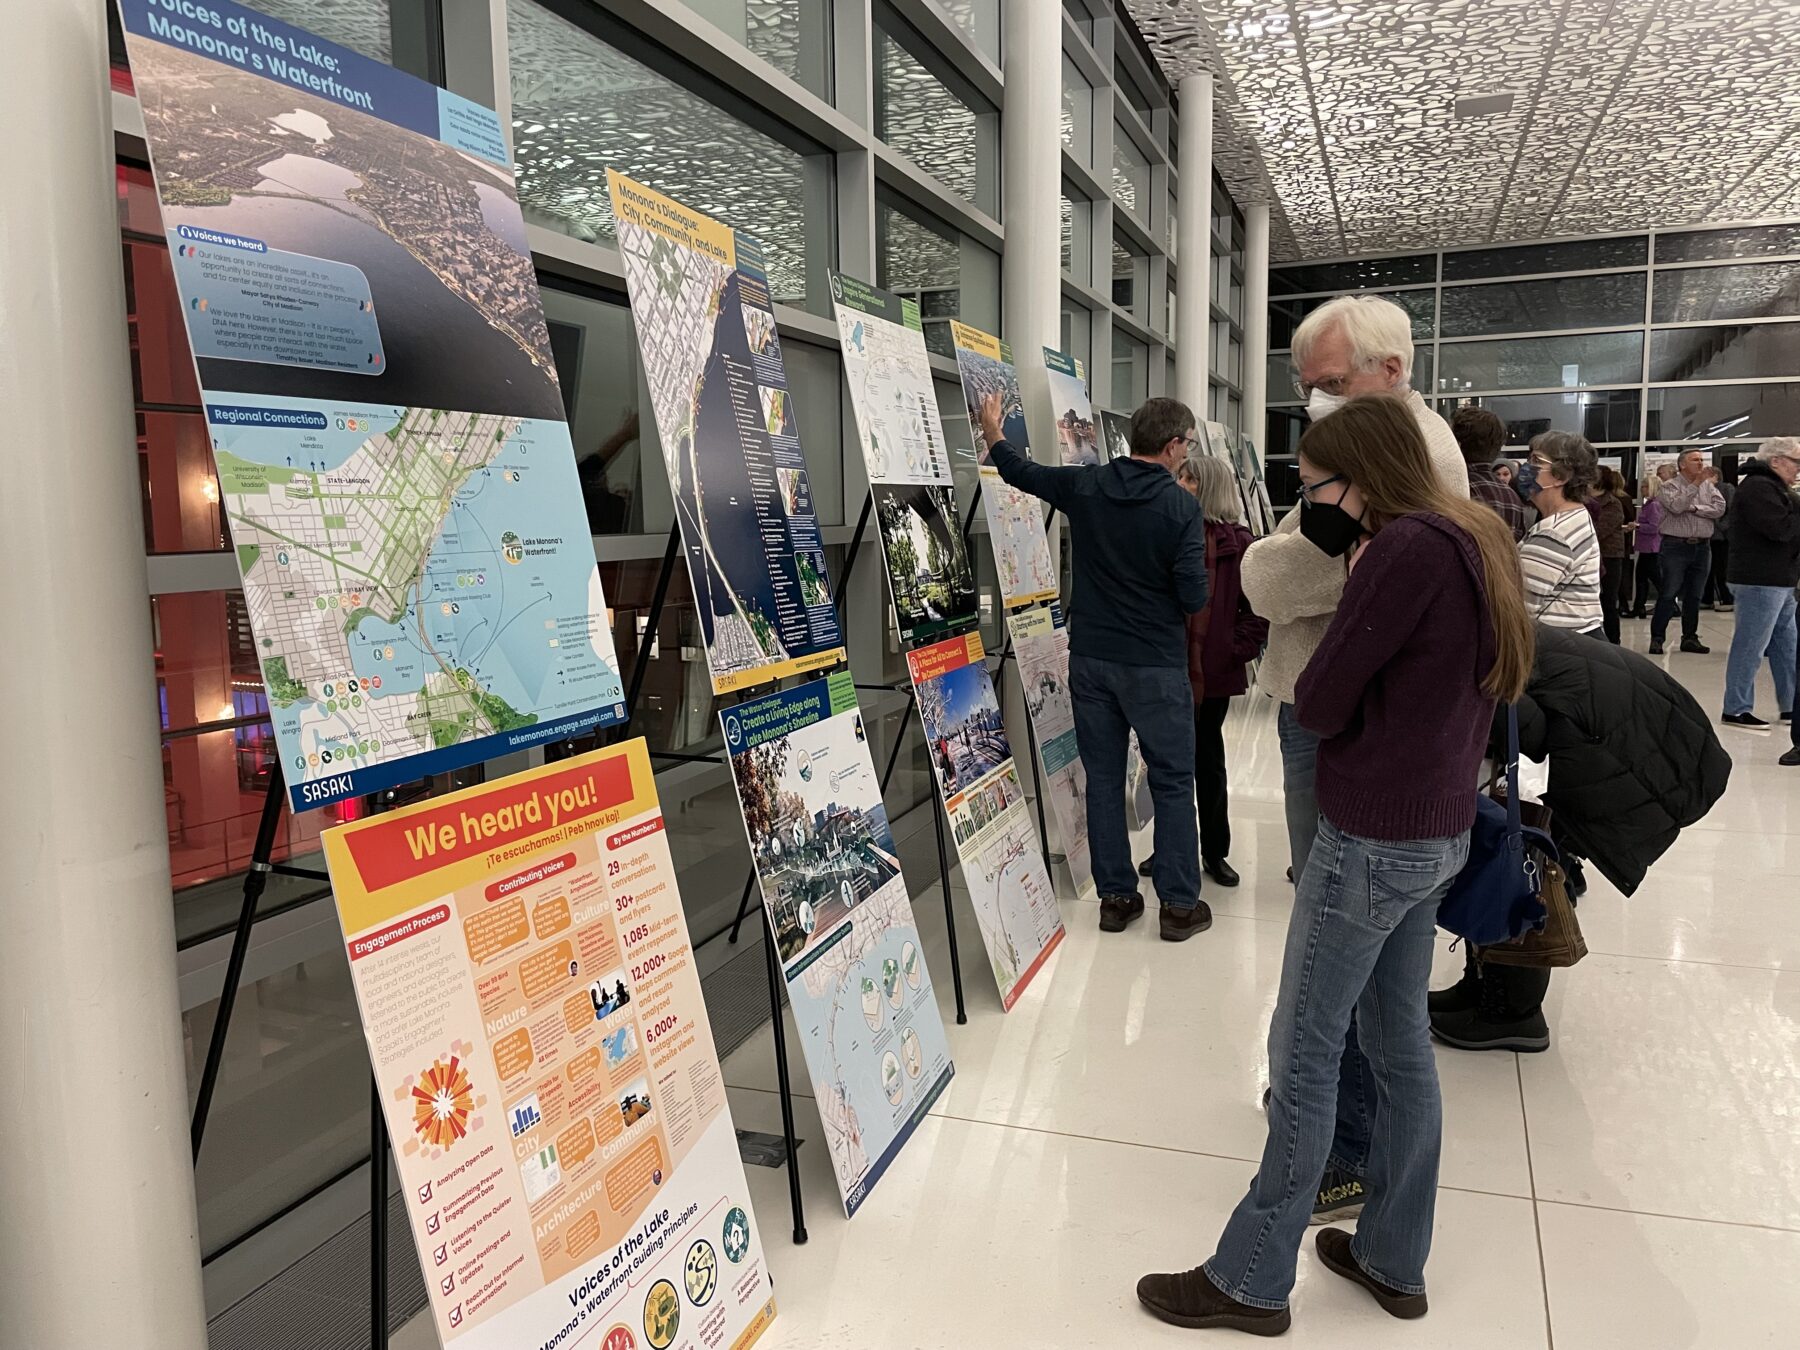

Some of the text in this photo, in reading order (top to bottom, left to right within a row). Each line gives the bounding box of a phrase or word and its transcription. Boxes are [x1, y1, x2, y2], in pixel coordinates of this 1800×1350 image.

[147, 12, 374, 110] Monona's Waterfront
[226, 17, 247, 38] of
[251, 23, 286, 52] the
[289, 38, 341, 74] Lake:
[618, 182, 700, 232] Monona's Dialogue:
[192, 230, 263, 252] Voices we heard
[622, 203, 645, 226] City,
[644, 213, 696, 249] Community,
[695, 238, 710, 253] and
[710, 243, 728, 261] Lake
[201, 261, 242, 276] opportunity
[203, 271, 218, 280] and
[228, 275, 251, 286] center
[215, 409, 262, 424] Regional
[264, 412, 325, 425] Connections
[523, 537, 563, 546] Lake Monona's
[509, 710, 615, 747] lakemonona.engage.sasaki.com
[739, 706, 750, 717] The
[742, 714, 767, 731] Create
[770, 705, 790, 722] Living
[789, 700, 804, 716] Edge
[803, 696, 820, 709] along
[745, 712, 820, 748] Lake Monona's Shoreline
[303, 775, 354, 803] SASAKI
[404, 776, 598, 861] We heard you!
[503, 829, 565, 860] escuchamos!
[568, 824, 584, 838] Peb
[584, 815, 605, 832] hnov
[605, 813, 620, 825] koj!
[621, 833, 631, 842] the
[498, 860, 565, 894] Contributing Voices
[607, 860, 620, 877] 29
[611, 863, 657, 889] conversations
[573, 900, 611, 924] Culture
[615, 881, 666, 911] 30+ postcards
[619, 903, 652, 925] and flyers
[623, 913, 679, 948] 1,085 Mid-term
[355, 910, 446, 954] Engagement Process
[628, 927, 678, 960] event responses
[631, 943, 689, 982] 12,000+ Google
[635, 959, 686, 995] Maps comments
[638, 981, 674, 1009] and results
[641, 996, 671, 1021] analyzed
[486, 1006, 528, 1037] Nature
[646, 1015, 678, 1042] 6,000+
[683, 1019, 696, 1033] and
[653, 1035, 697, 1070] website views
[568, 1082, 601, 1109] Accessibility
[516, 1133, 540, 1157] City
[602, 1110, 657, 1159] Community
[437, 1145, 494, 1188] Analyzing Open Data
[442, 1167, 504, 1214] Summarizing Previous
[445, 1184, 495, 1223] Engagement Data
[1320, 1181, 1363, 1205] HOKA
[450, 1196, 512, 1246] Listening to the Quieter
[535, 1180, 602, 1241] Architecture
[452, 1238, 473, 1255] Voices
[458, 1229, 511, 1275] Online Postings and
[568, 1263, 611, 1308] Voices
[612, 1245, 625, 1269] of
[624, 1233, 644, 1257] the
[644, 1208, 669, 1239] Lake
[586, 1267, 633, 1313] Waterfront
[632, 1235, 664, 1269] Guiding
[663, 1202, 698, 1241] Principles
[460, 1263, 484, 1285] Updates
[465, 1253, 525, 1306] Reach Out for Informal
[468, 1280, 507, 1316] Conversations
